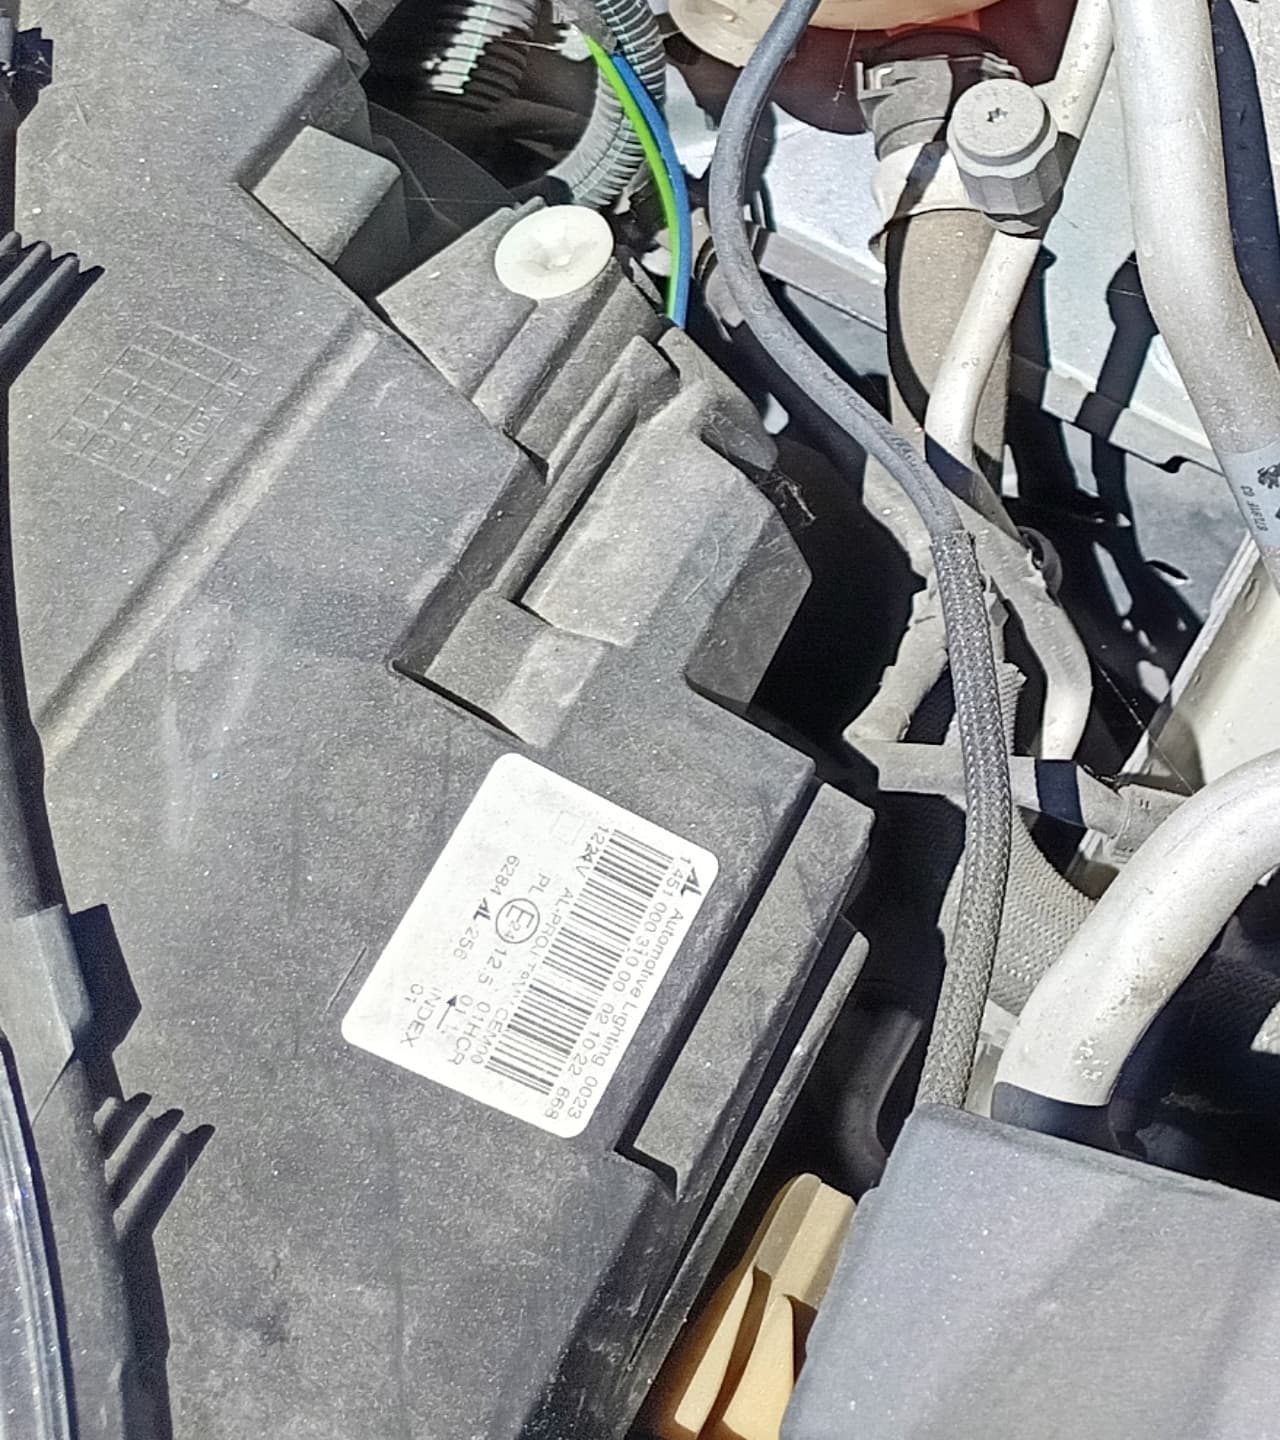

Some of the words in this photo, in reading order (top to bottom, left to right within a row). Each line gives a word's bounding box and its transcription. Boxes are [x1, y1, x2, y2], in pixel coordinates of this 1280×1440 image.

[488, 853, 520, 896] 6284
[527, 871, 550, 899] PL
[641, 900, 668, 934] 000
[451, 925, 480, 962] 256
[623, 934, 651, 969] 310
[627, 906, 686, 999] Automotive
[610, 968, 632, 993] 00
[399, 985, 443, 1050] INDEX
[588, 998, 637, 1069] Lighting
[580, 1026, 601, 1051] 10
[567, 1052, 588, 1077] 22
[543, 1084, 571, 1122] 668
[565, 1073, 599, 1121] 0023
